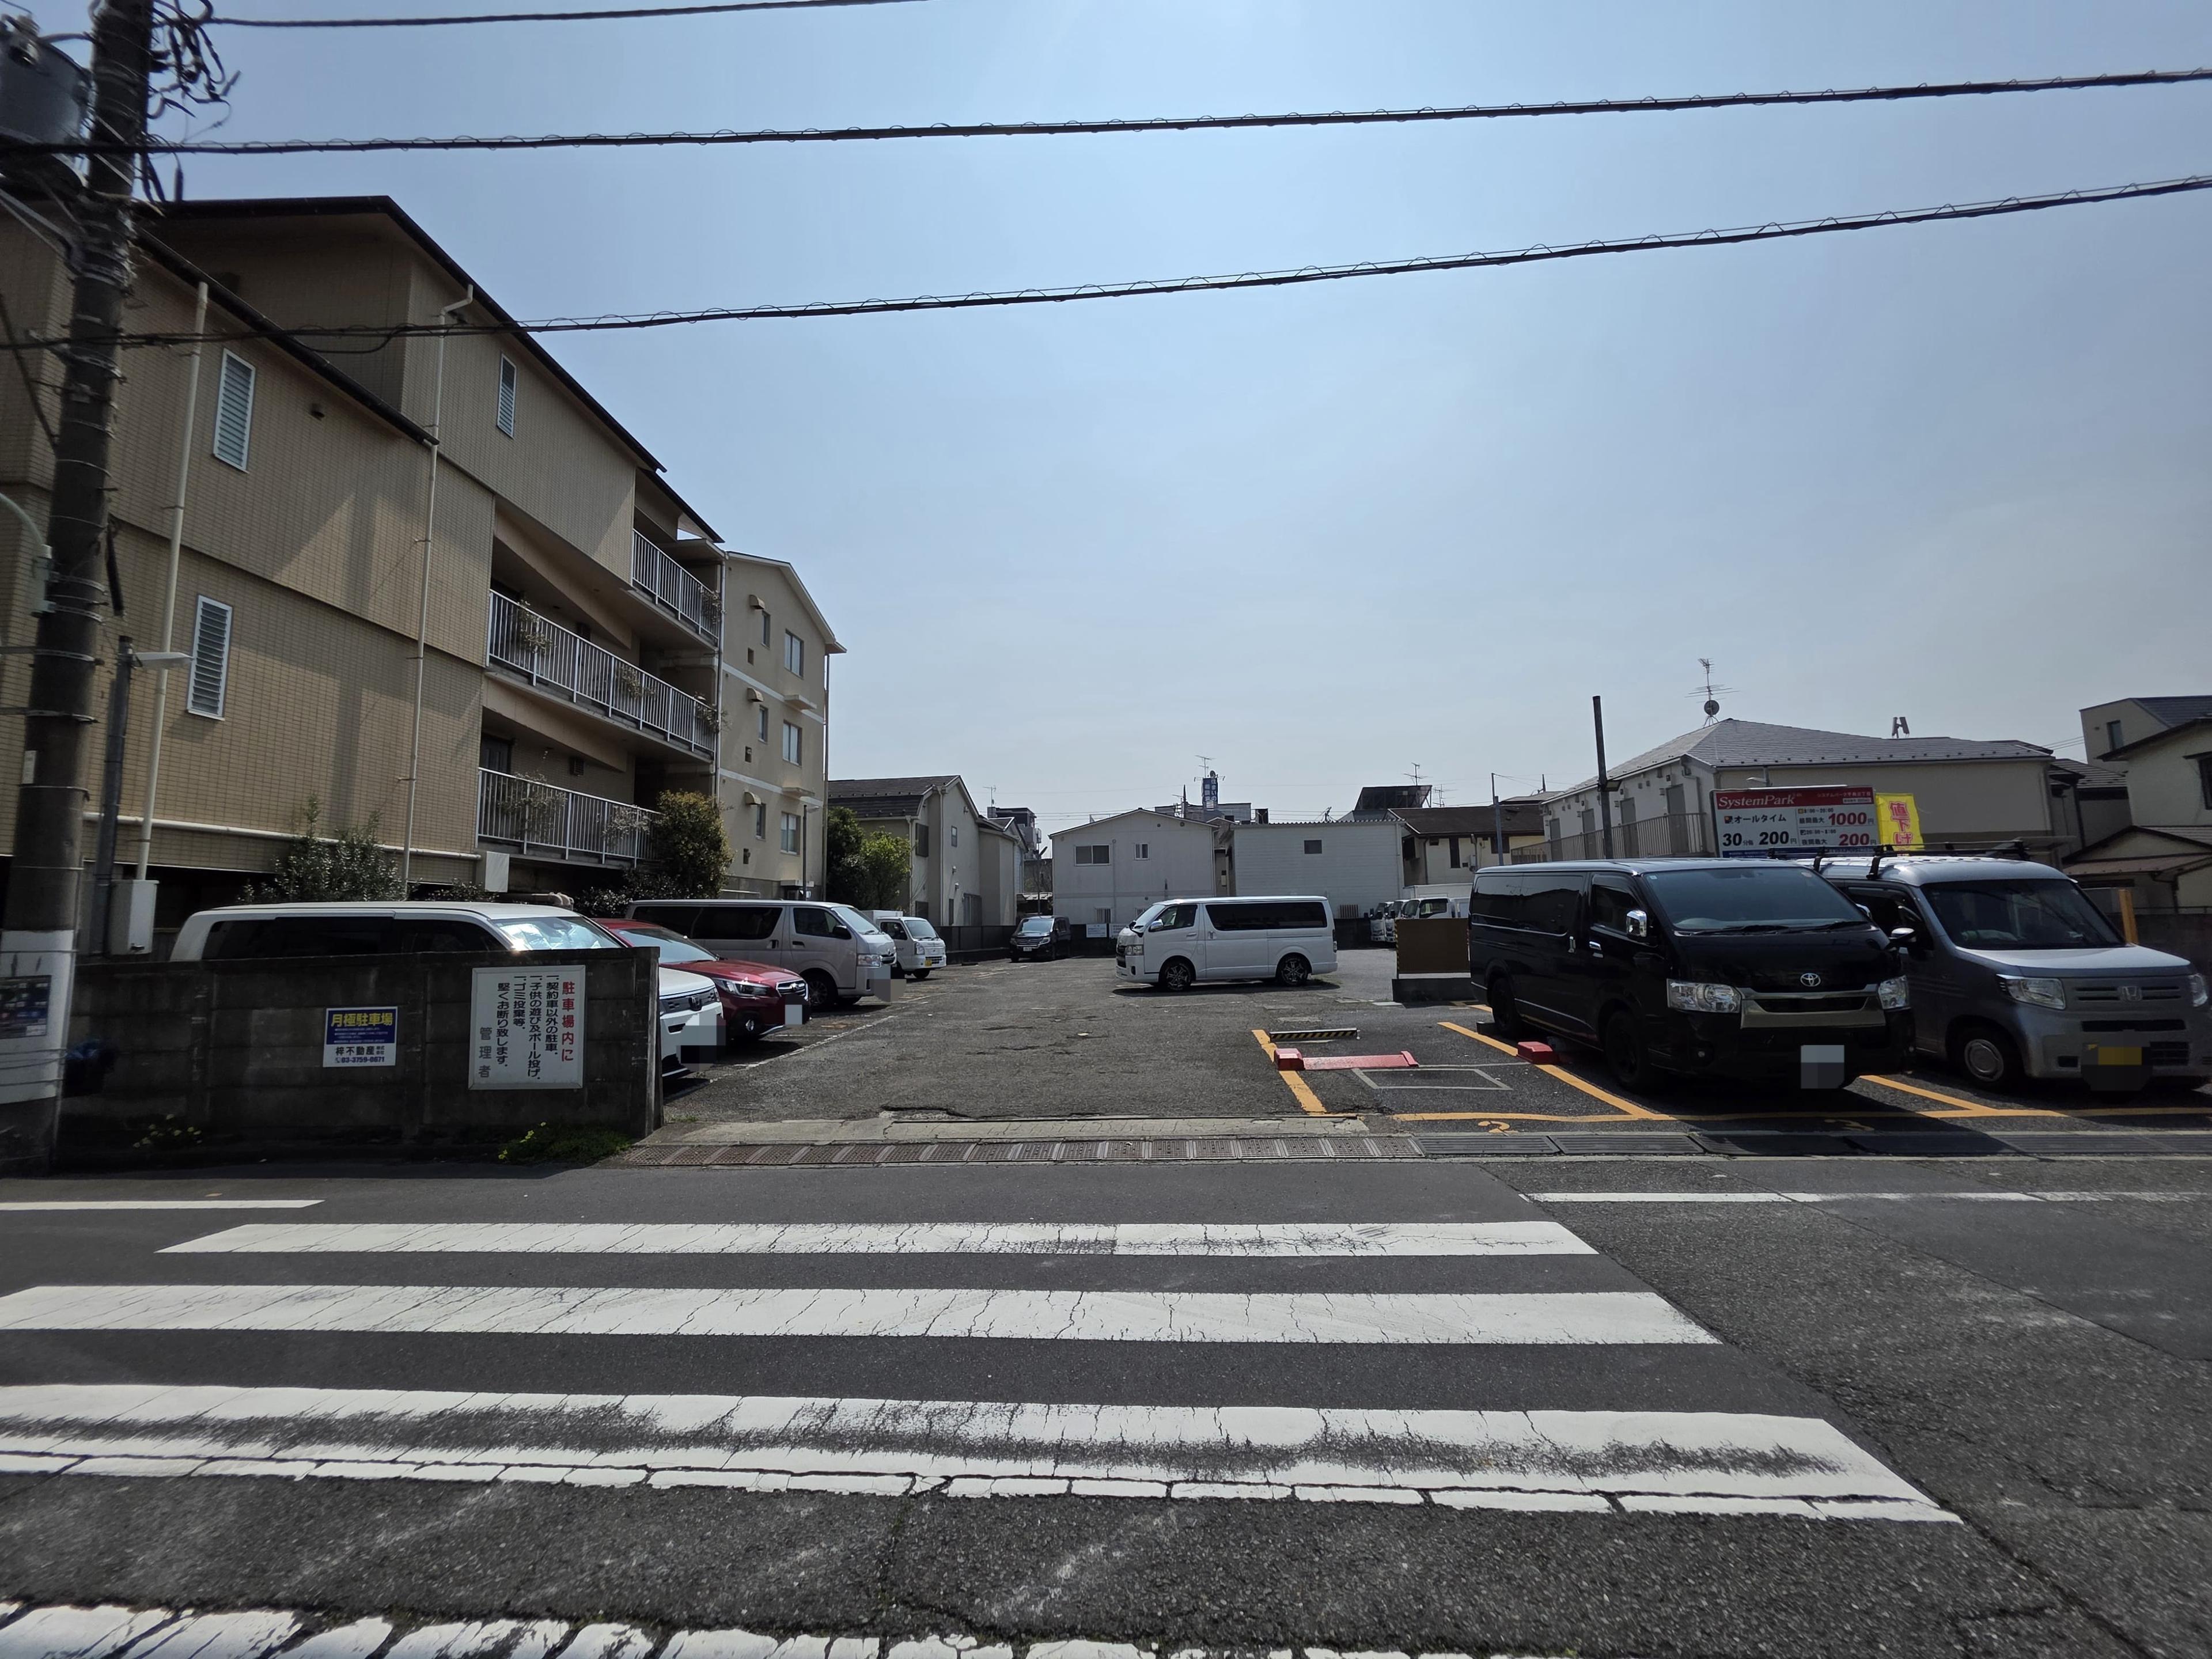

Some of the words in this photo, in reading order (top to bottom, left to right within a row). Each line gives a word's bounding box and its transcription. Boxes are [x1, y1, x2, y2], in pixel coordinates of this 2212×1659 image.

[1718, 794, 1796, 809] SystemPark
[1734, 813, 1787, 824] オールタイム
[331, 1012, 393, 1027] 月極駐車場
[562, 982, 575, 1062] 駐車場内に
[478, 1027, 493, 1078] 管理者
